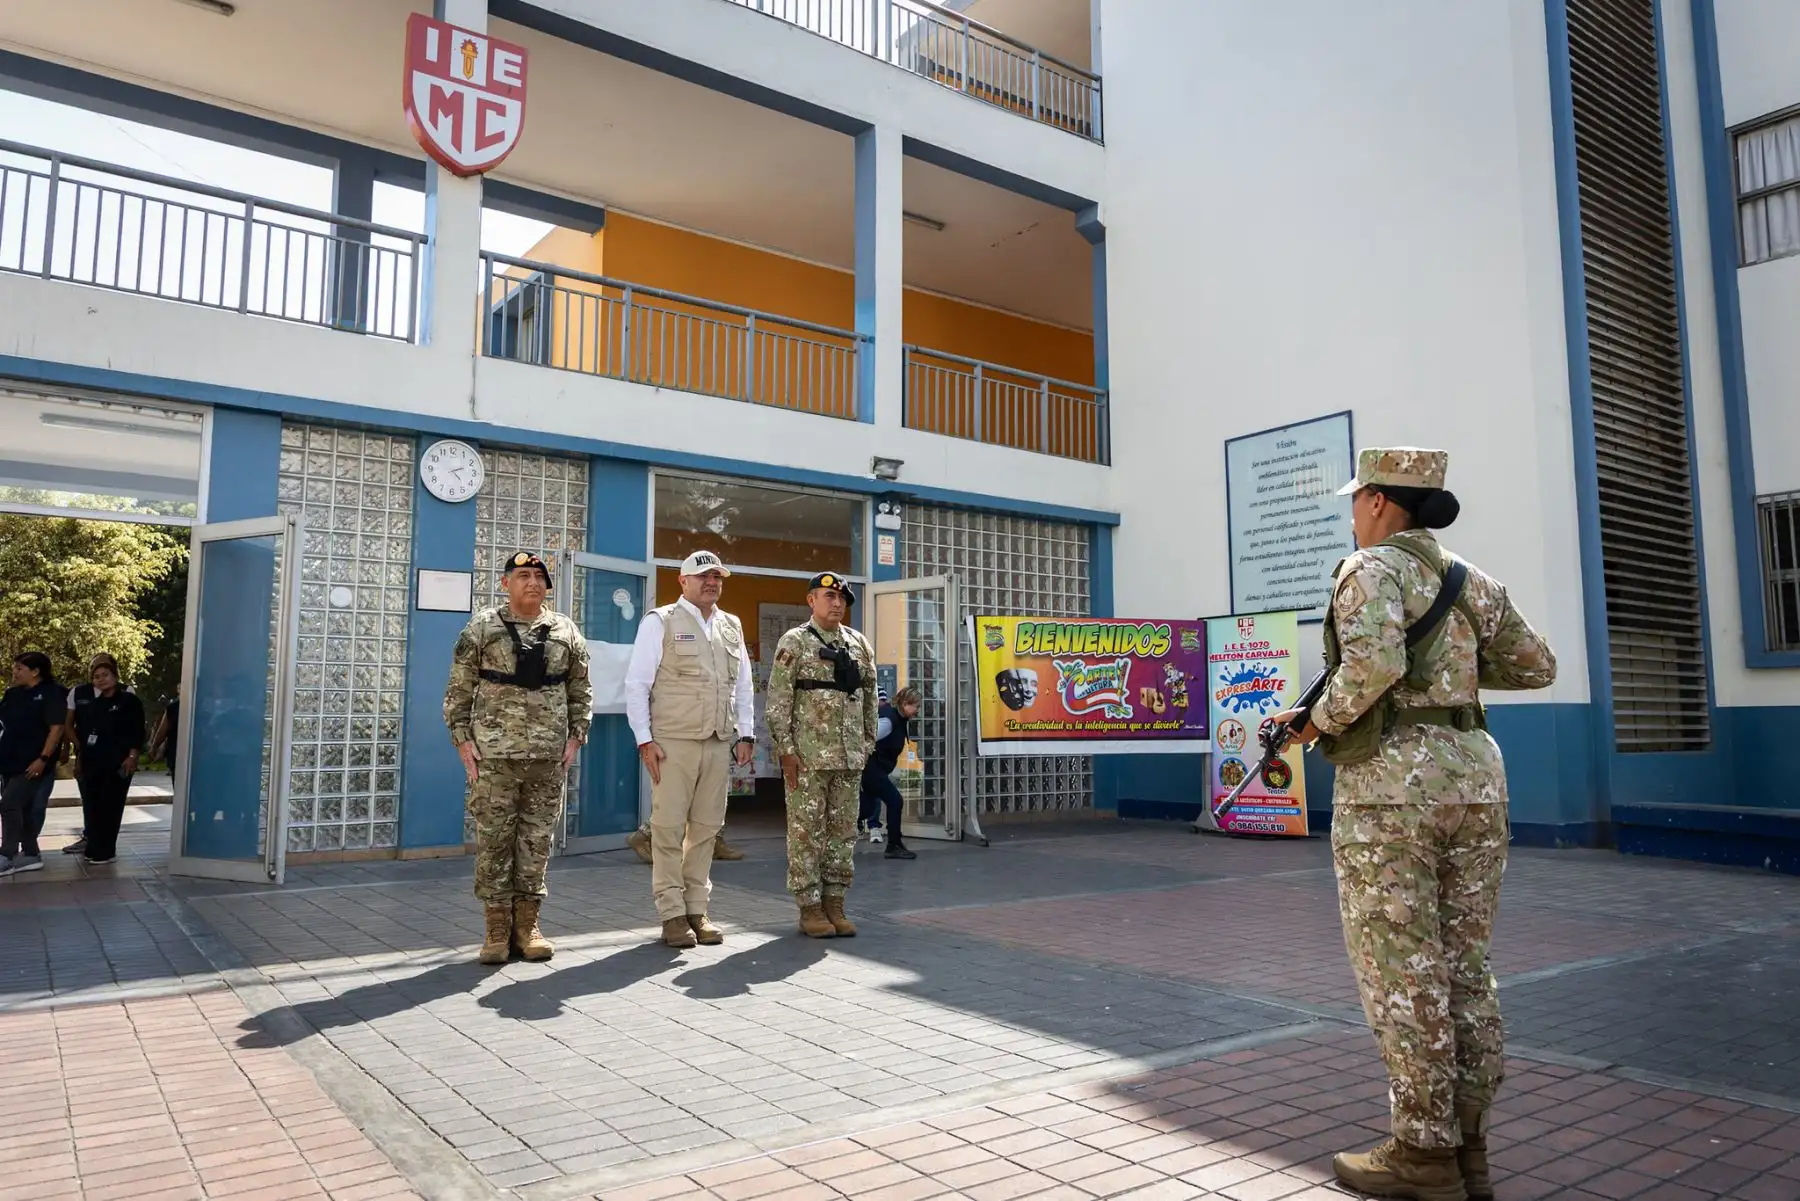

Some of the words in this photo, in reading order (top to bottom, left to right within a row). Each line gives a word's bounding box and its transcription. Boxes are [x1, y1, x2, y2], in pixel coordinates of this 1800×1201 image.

[440, 448, 446, 456] 11
[449, 446, 457, 456] 12
[462, 450, 466, 459] 1
[431, 455, 440, 463] 10
[469, 459, 474, 467] 2
[431, 475, 437, 484] 8
[468, 479, 474, 487] 4
[1275, 479, 1294, 489] calidad
[449, 488, 455, 496] 6
[459, 486, 466, 494] 5
[1288, 533, 1305, 544] padres
[1296, 558, 1318, 568] cultural
[1015, 621, 1171, 657] BIENVENIDOS
[1248, 641, 1270, 650] 1070
[1245, 649, 1290, 659] CARVAJAL
[1022, 719, 1064, 730] creatividad
[1075, 719, 1083, 730] la
[1085, 719, 1127, 733] inteligencia
[1129, 722, 1142, 733] que
[1144, 722, 1151, 730] se
